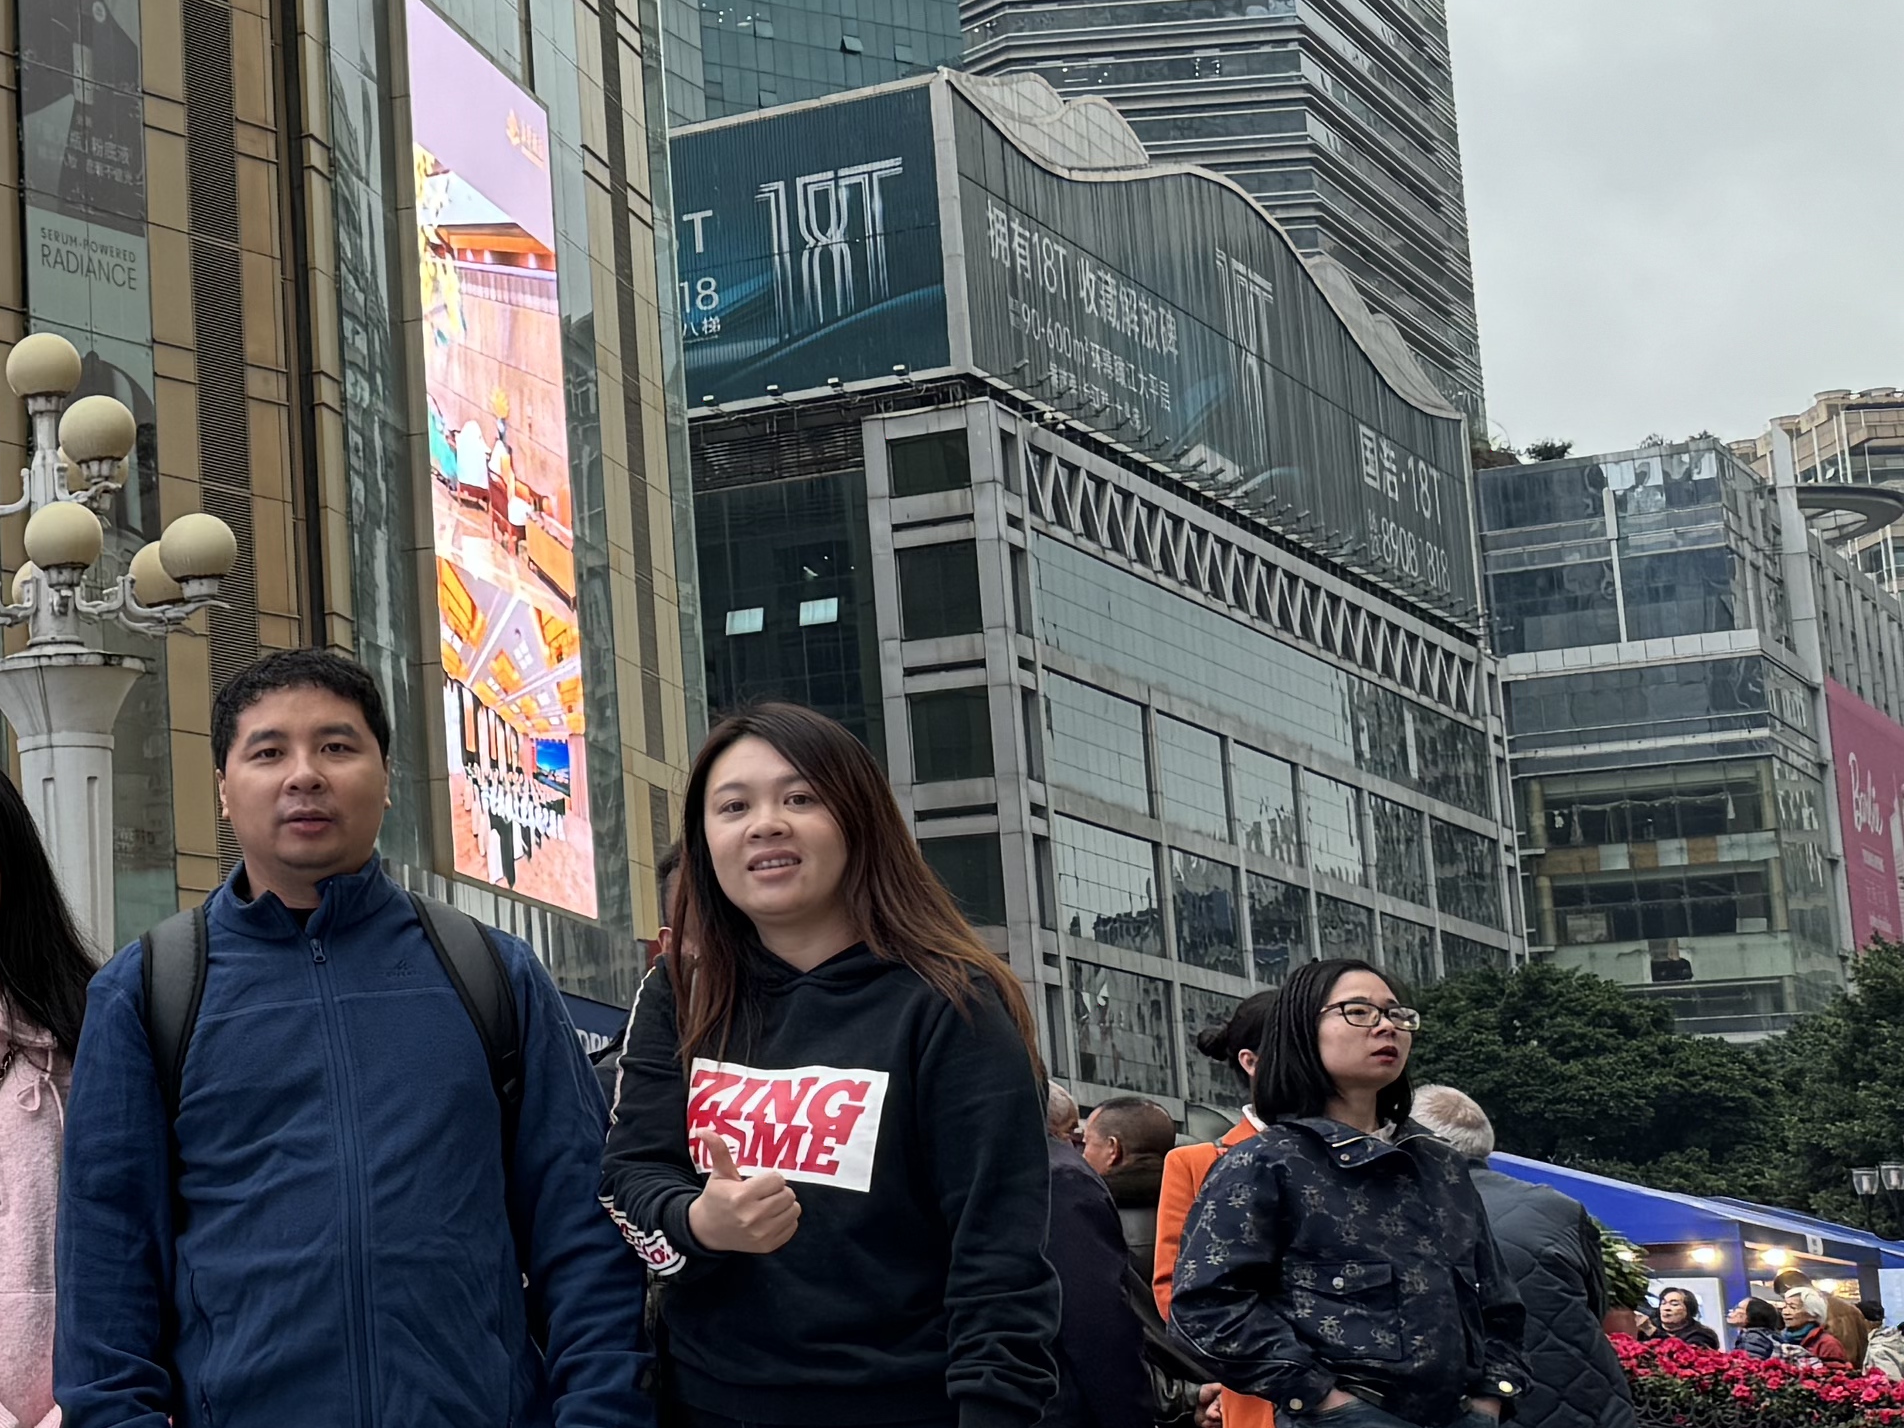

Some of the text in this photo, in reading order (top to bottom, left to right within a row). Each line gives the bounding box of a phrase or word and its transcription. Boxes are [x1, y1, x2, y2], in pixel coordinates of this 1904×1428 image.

[40, 242, 138, 291] RADIANCE
[986, 198, 1179, 364] 拥有18T 收藏解放碑
